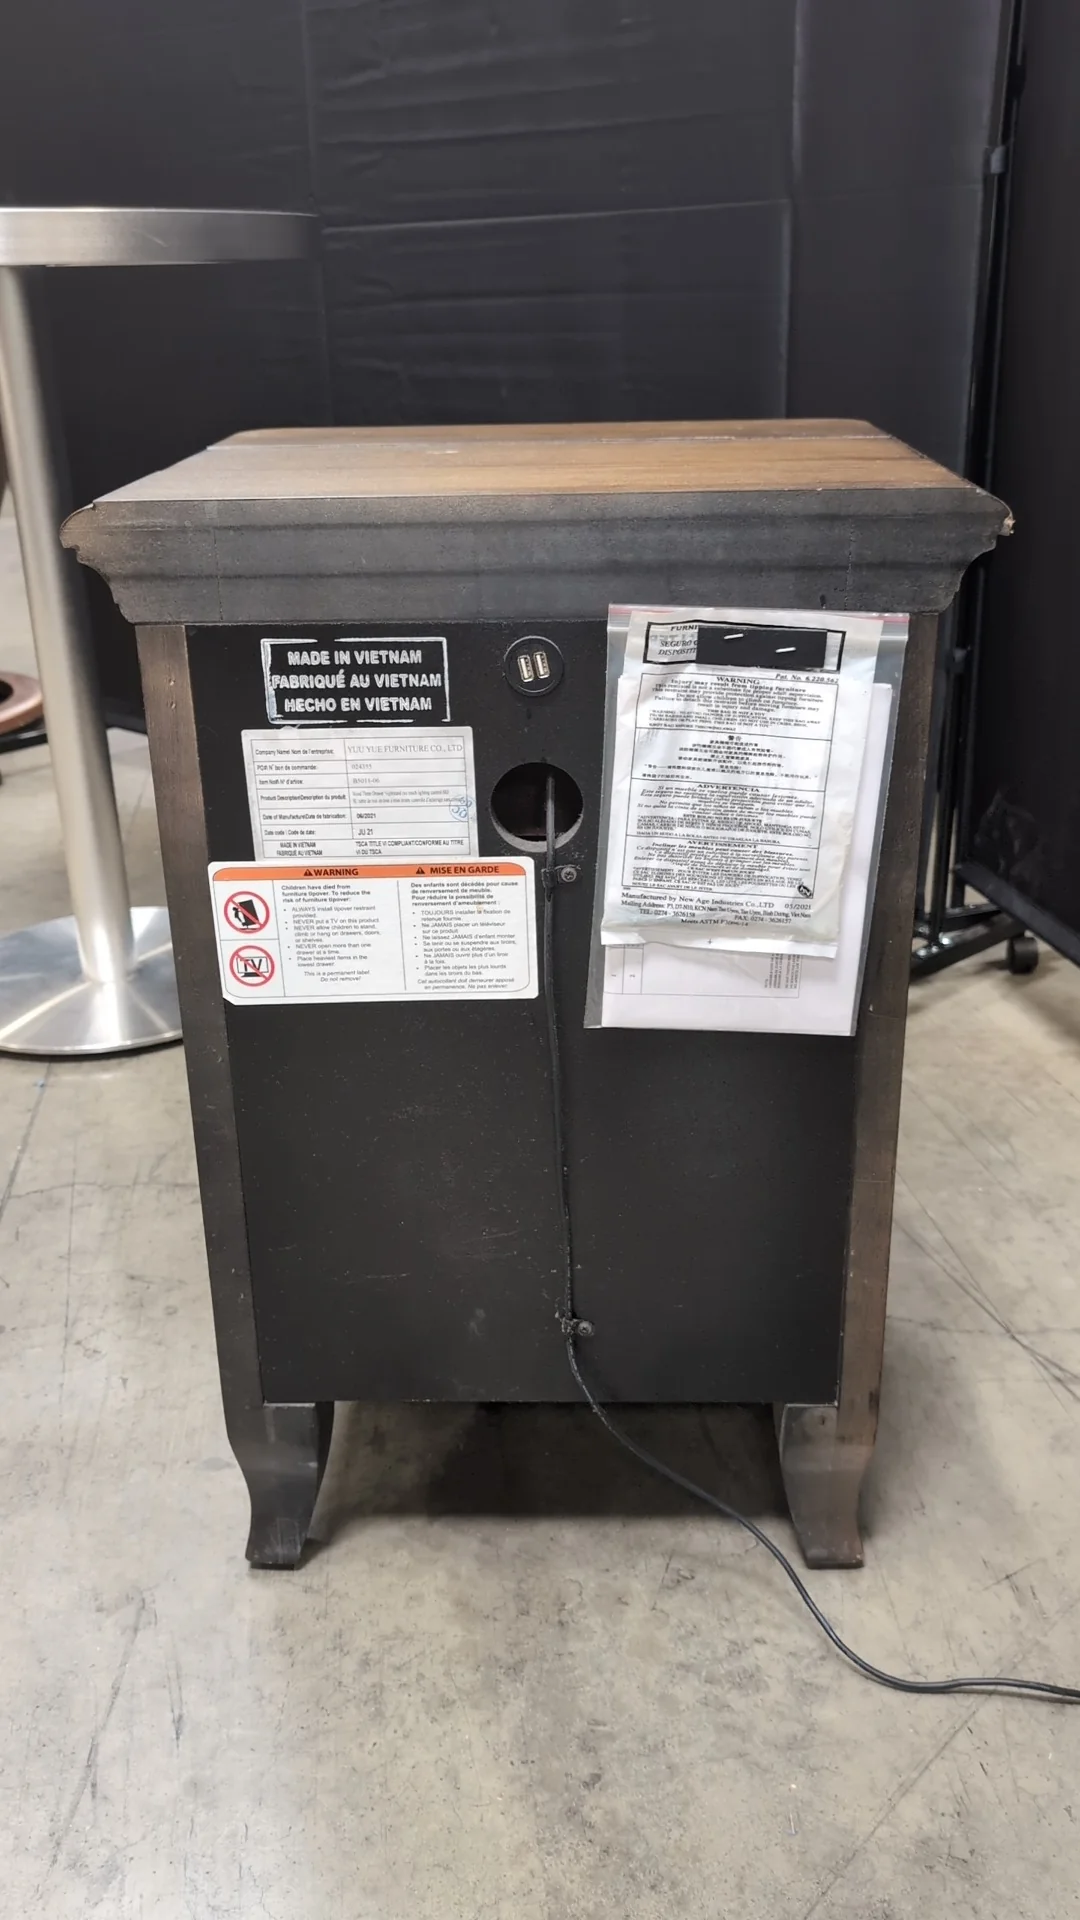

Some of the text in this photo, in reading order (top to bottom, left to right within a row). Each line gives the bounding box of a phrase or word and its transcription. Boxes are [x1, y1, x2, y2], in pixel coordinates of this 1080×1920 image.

[287, 650, 422, 665] MADE IN VIETNAM
[271, 669, 442, 689] FABRIQUÉ AU VIETNAM
[717, 676, 760, 685] WARNING
[285, 697, 432, 712] HECHO EN VIETNAM
